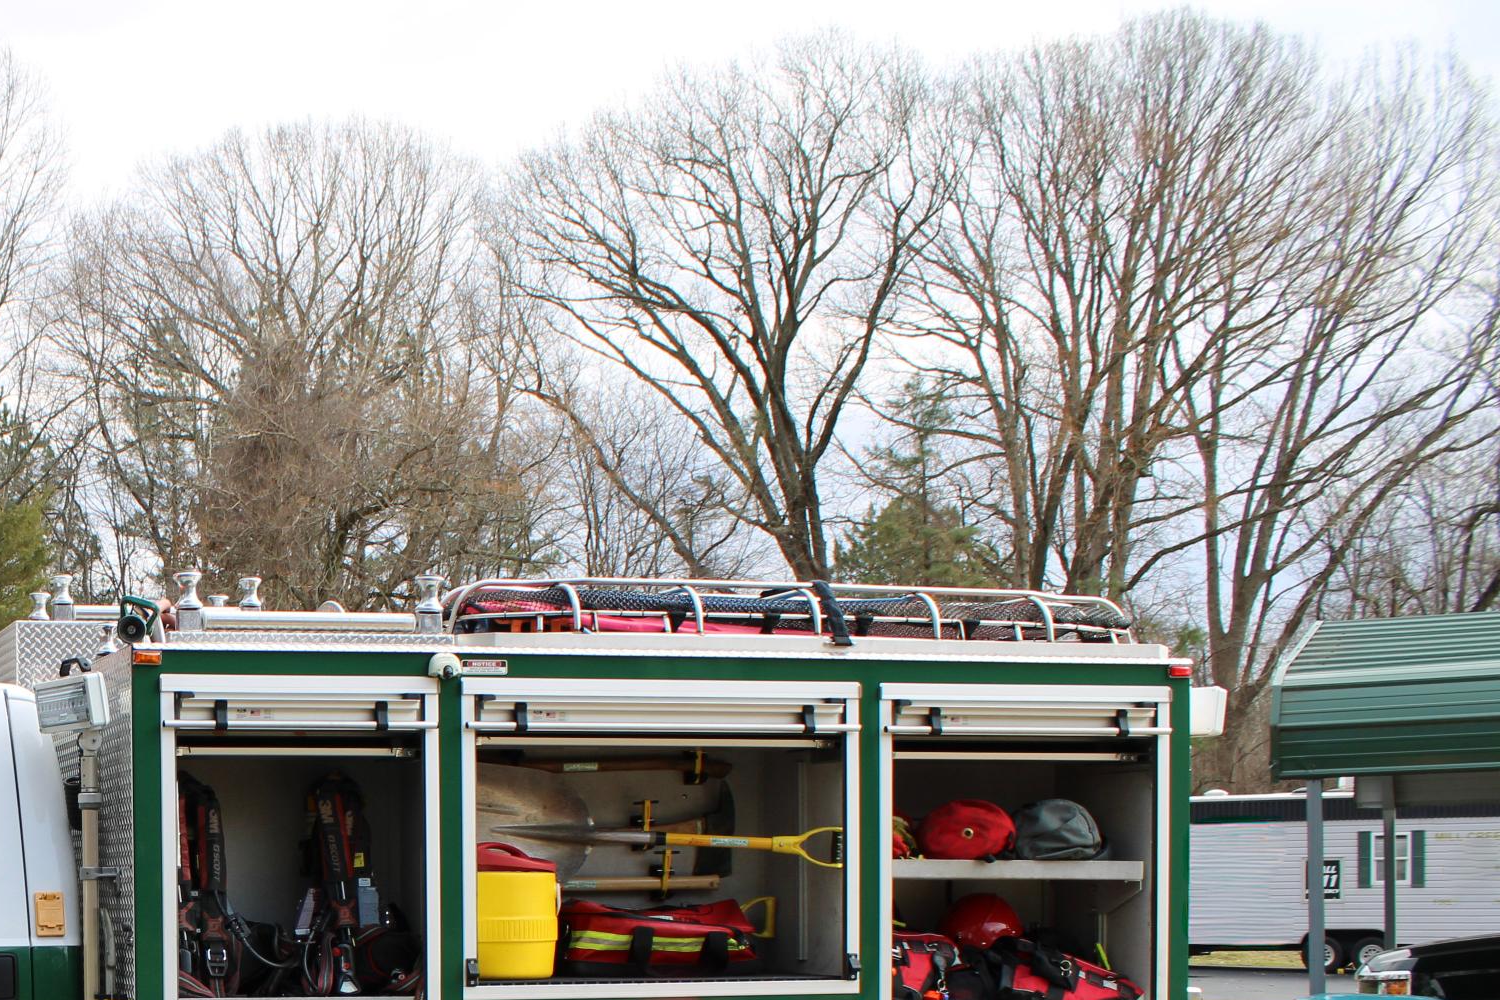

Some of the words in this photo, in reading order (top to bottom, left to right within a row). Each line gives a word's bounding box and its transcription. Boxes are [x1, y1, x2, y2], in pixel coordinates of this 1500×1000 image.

[209, 809, 220, 833] 3M
[318, 800, 334, 823] 3M
[212, 852, 221, 881] SCOTT
[1323, 875, 1338, 887] 11
